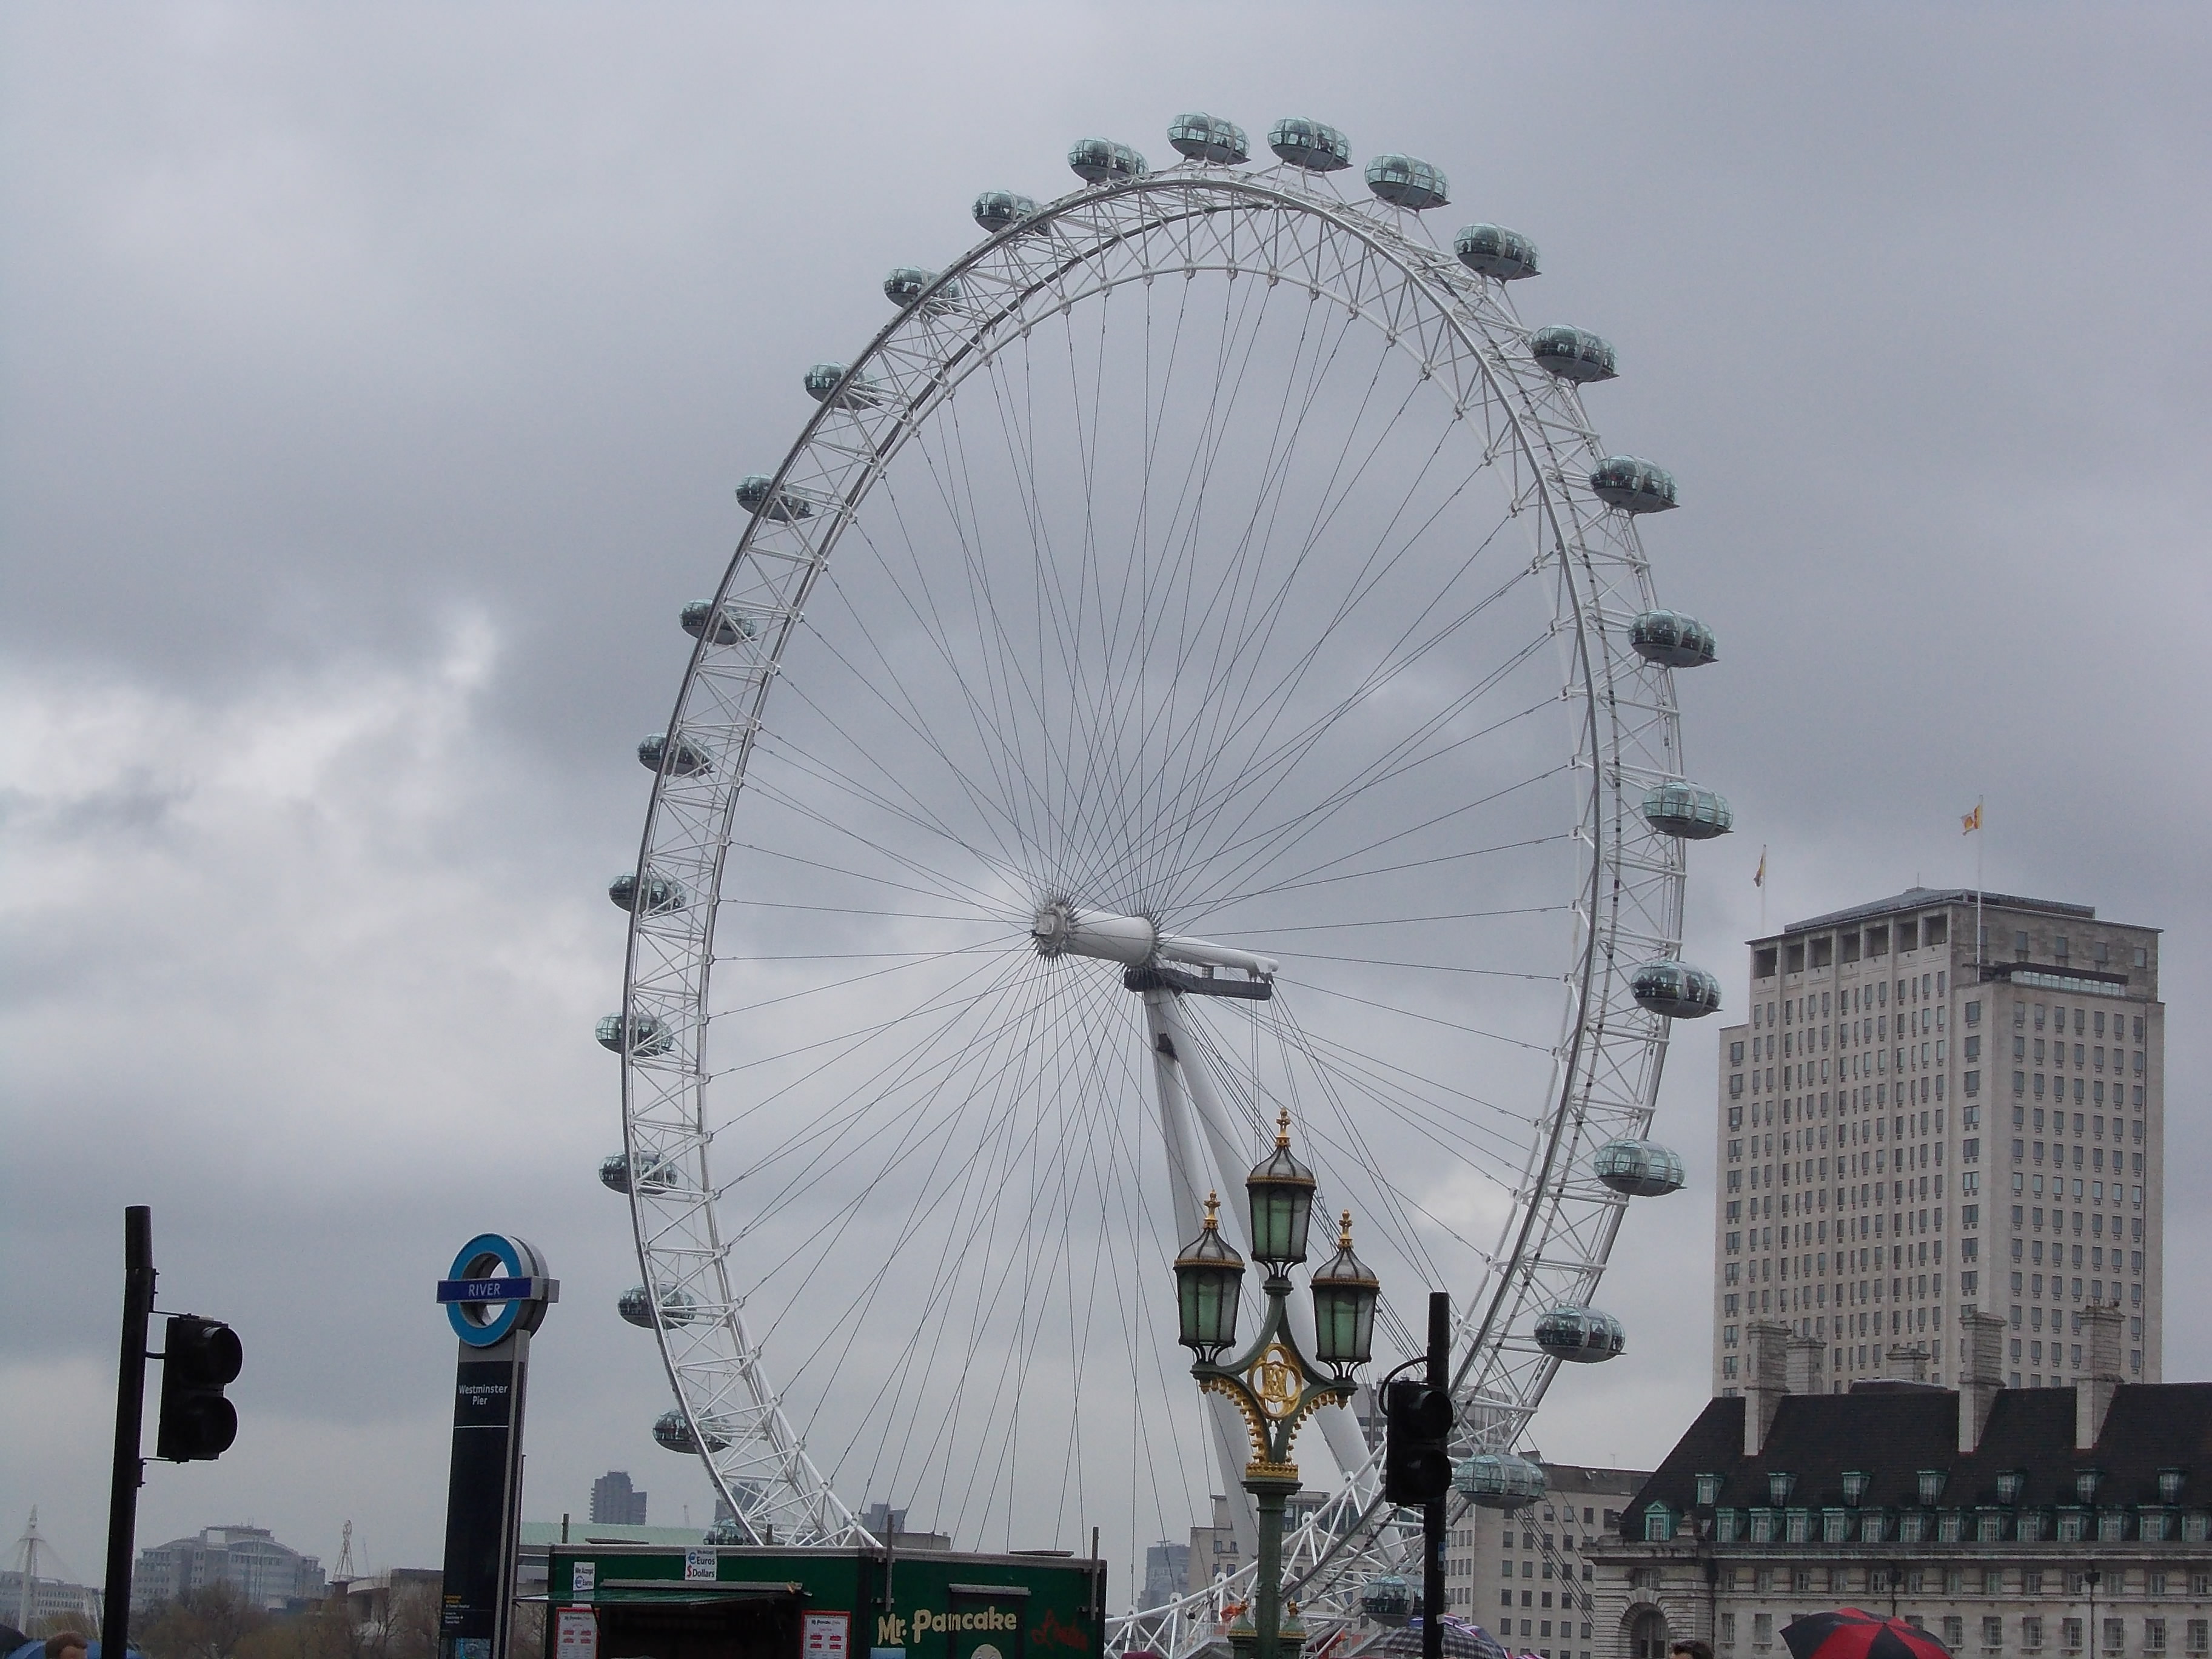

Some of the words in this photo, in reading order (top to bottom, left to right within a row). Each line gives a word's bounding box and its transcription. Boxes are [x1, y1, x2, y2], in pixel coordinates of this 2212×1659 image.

[468, 1283, 500, 1296] RIVER
[459, 1384, 508, 1395] Westminster
[472, 1396, 488, 1406] Pier
[697, 1556, 715, 1565] Euros
[692, 1569, 715, 1578] Dollars
[877, 1612, 907, 1645] Mr.
[912, 1606, 1017, 1643] Pancake
